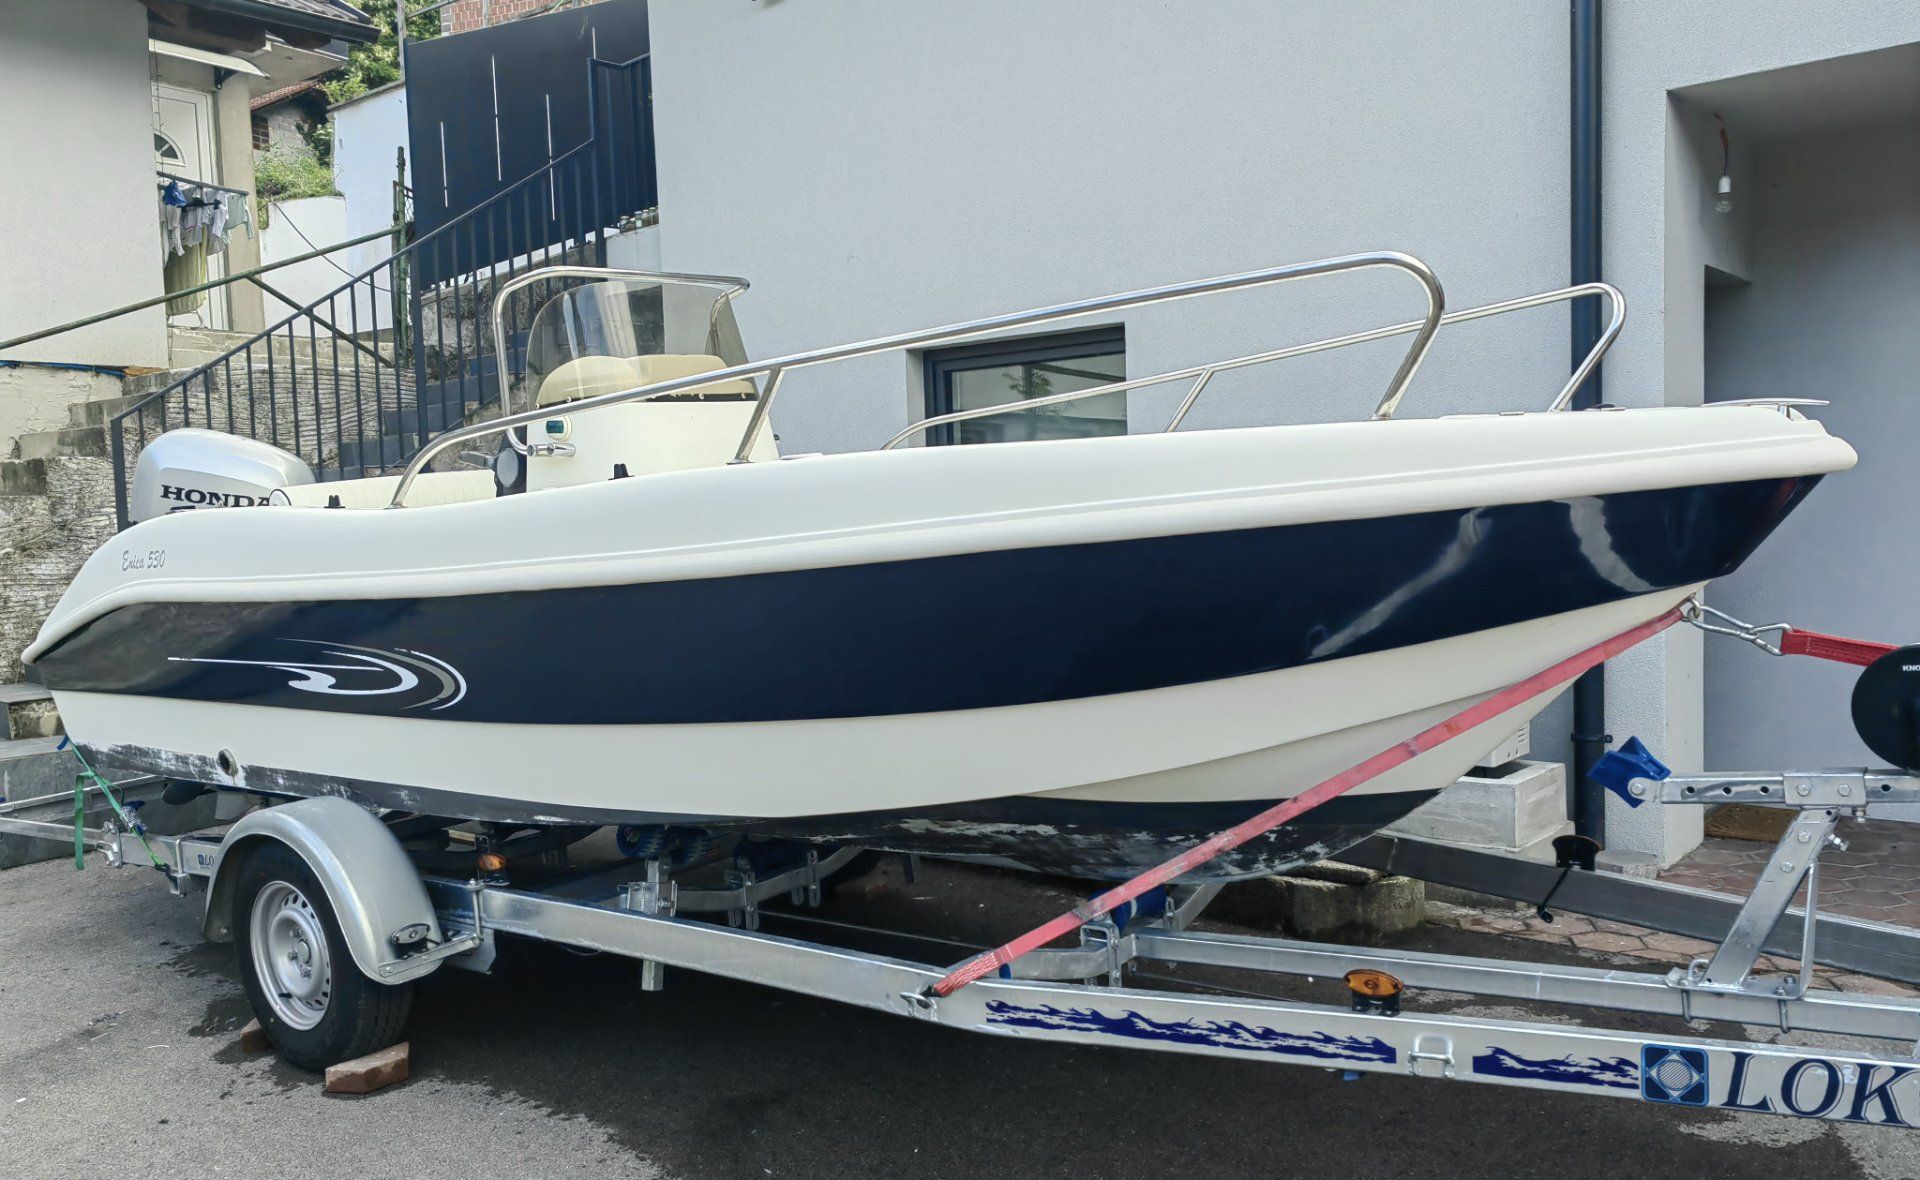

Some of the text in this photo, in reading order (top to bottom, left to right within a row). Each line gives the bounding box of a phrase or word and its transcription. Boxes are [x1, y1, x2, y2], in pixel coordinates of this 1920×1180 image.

[160, 484, 270, 507] HONDA
[147, 549, 166, 569] 530
[1902, 664, 1920, 672] KNO
[204, 854, 214, 867] LO
[1720, 1051, 1919, 1128] LOK
